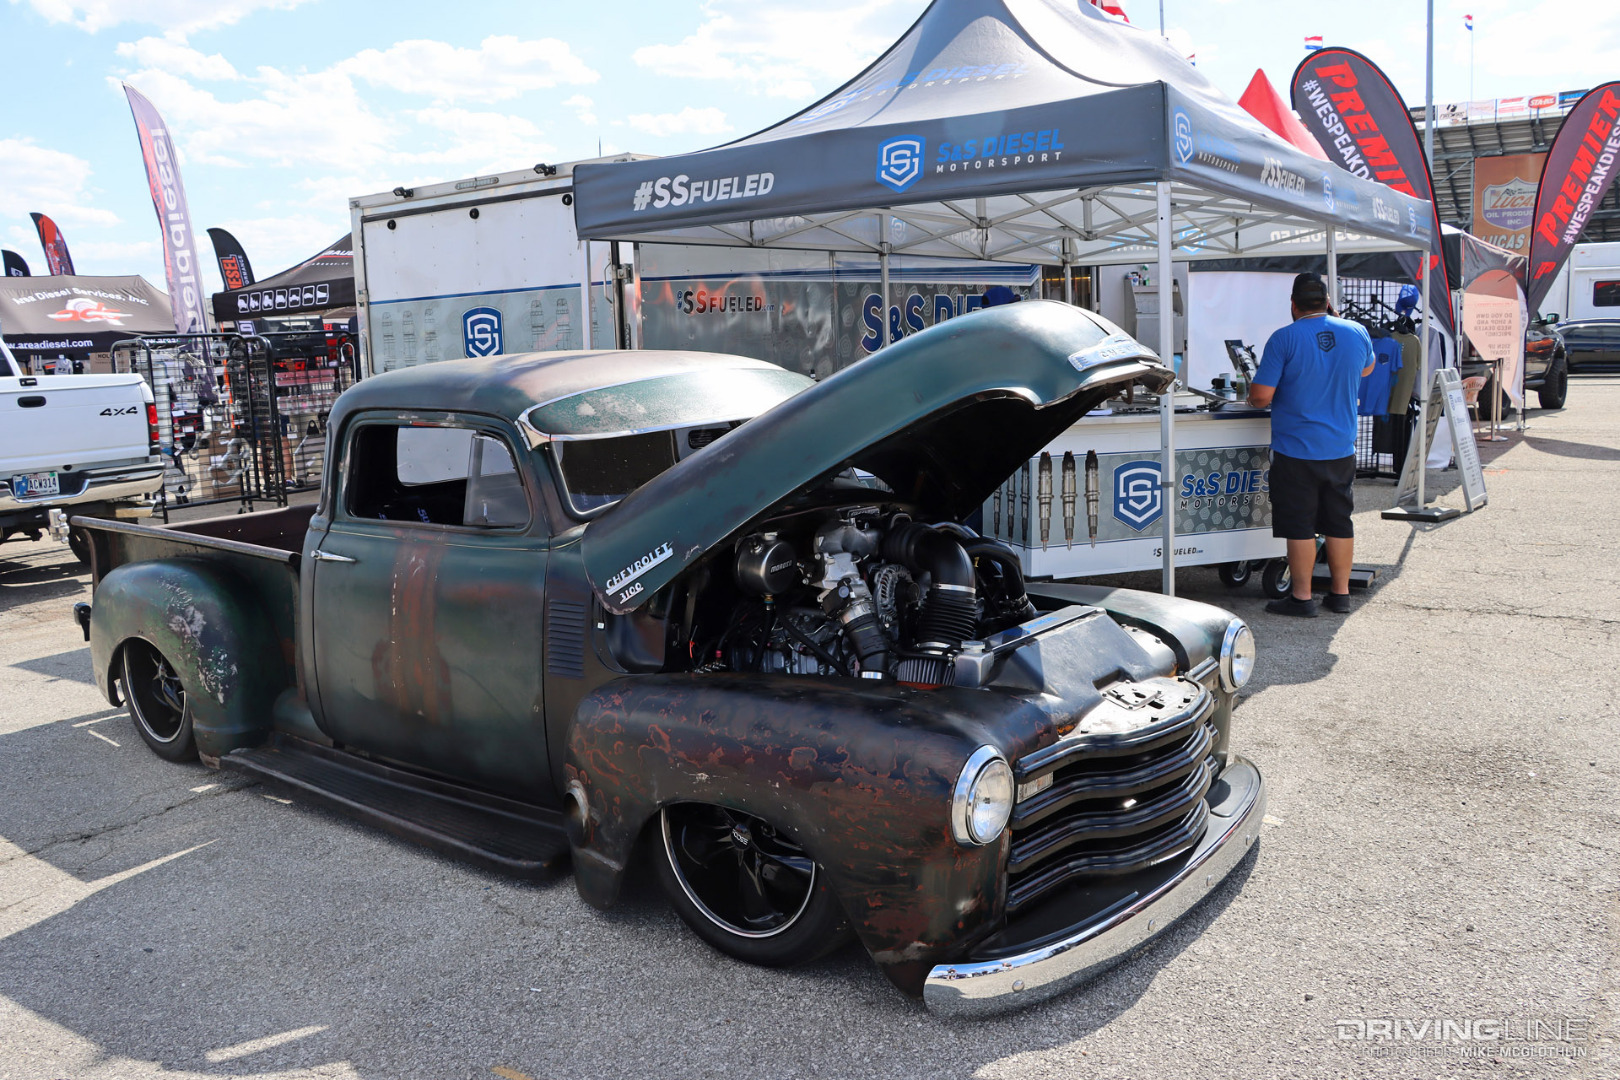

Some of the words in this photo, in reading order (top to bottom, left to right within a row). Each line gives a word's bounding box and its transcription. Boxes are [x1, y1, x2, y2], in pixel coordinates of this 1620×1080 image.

[923, 63, 1029, 82] DIESEL
[860, 73, 1024, 102] MOTORSPORT
[1302, 79, 1376, 183] #WESPEAKD
[935, 139, 978, 163] S&S
[981, 128, 1065, 158] DIESEL
[935, 151, 1062, 174] MOTORSPORT
[1259, 157, 1306, 198] #SSFUELED
[633, 172, 775, 212] #SSFUELED
[1490, 195, 1535, 209] LUCA
[1502, 210, 1534, 218] PRODUC
[12, 292, 37, 306] Area
[35, 288, 71, 301] Diesel
[73, 287, 126, 301] Services,
[129, 294, 149, 306] Inc.
[1180, 471, 1222, 499] S&S
[606, 541, 669, 590] CHEVROLET
[619, 582, 644, 601] 3100
